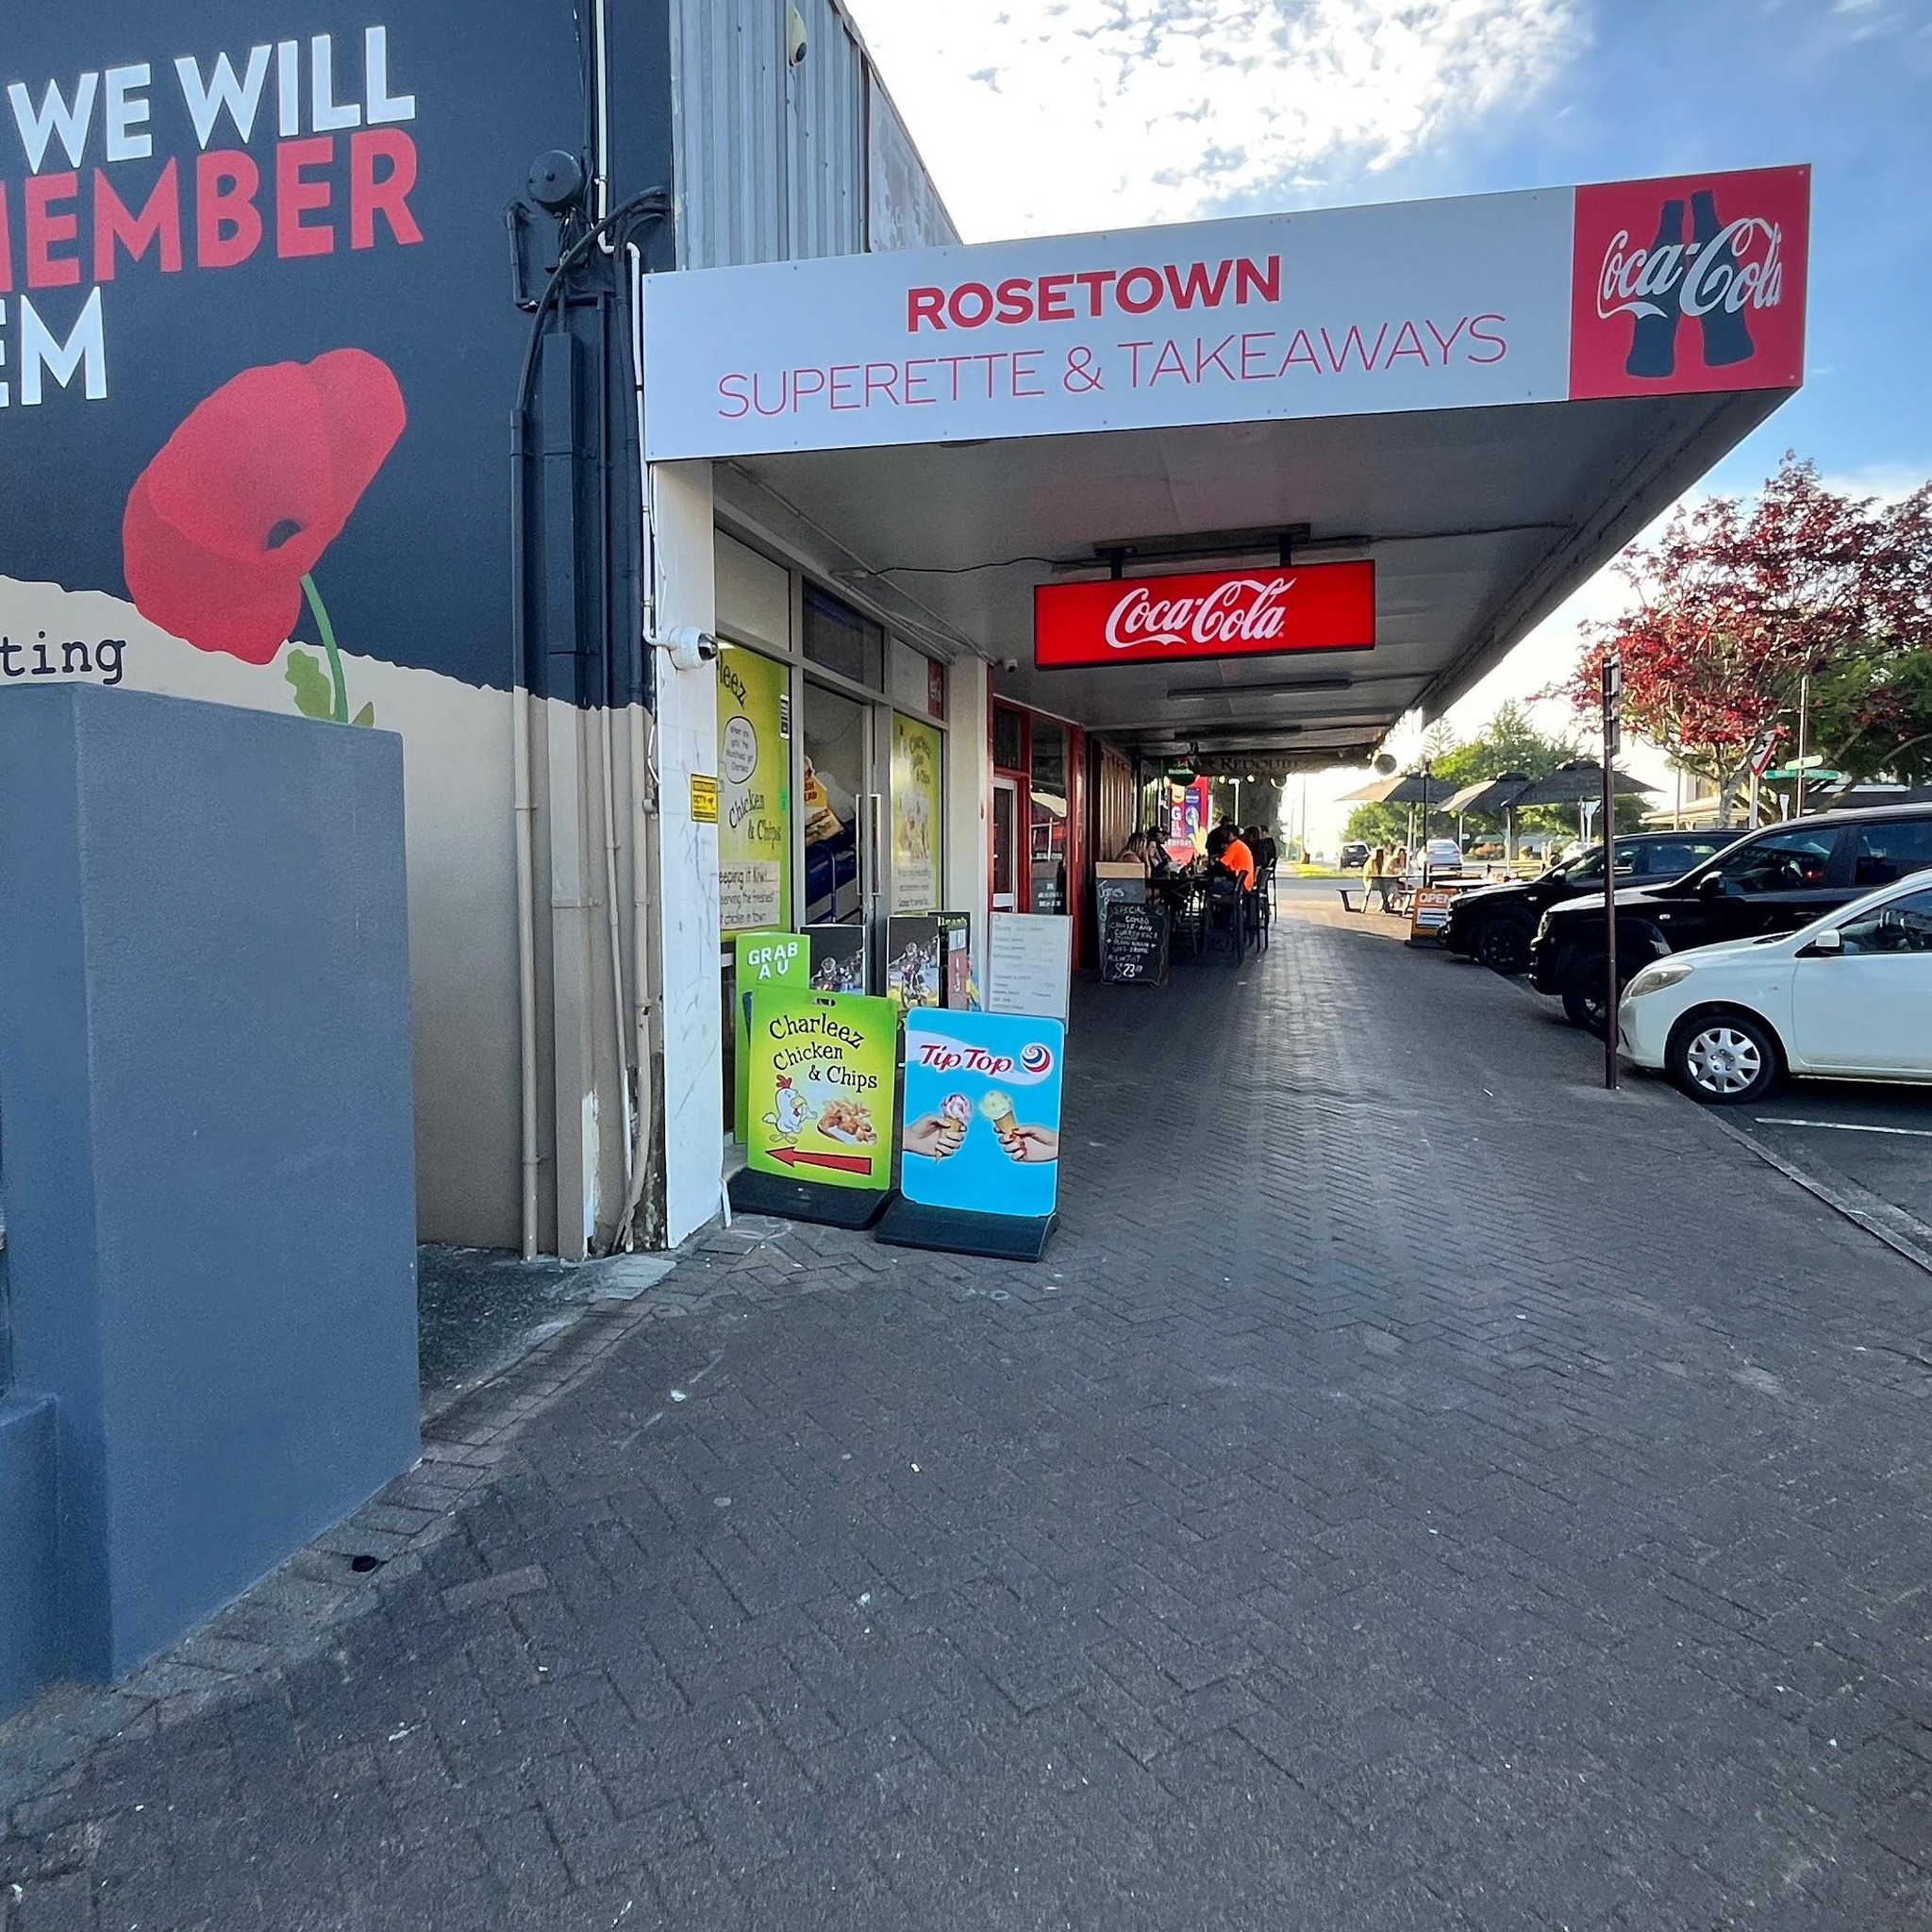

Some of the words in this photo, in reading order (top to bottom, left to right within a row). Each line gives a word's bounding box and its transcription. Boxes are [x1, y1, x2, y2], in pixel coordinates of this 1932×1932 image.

[8, 63, 152, 175] WE
[175, 25, 416, 150] WILL
[0, 128, 424, 293] EMBER
[907, 255, 1281, 333] ROSETOWN
[1597, 218, 1783, 320] Coca-Cola
[0, 285, 108, 408] M
[717, 350, 1044, 419] SUPERETTE
[1062, 345, 1105, 393] &
[1118, 314, 1507, 389] TAKEAWAYS
[1105, 577, 1297, 649] Coca-Cola
[0, 630, 127, 685] ting
[717, 651, 747, 710] leez
[748, 941, 799, 966] GRAB
[758, 963, 772, 981] A
[769, 1012, 865, 1049] Charleez
[773, 1041, 843, 1071] Chicken
[920, 1044, 961, 1071] Tip
[963, 1048, 1012, 1075] Top
[808, 1064, 821, 1081] &
[826, 1065, 877, 1092] Chips
